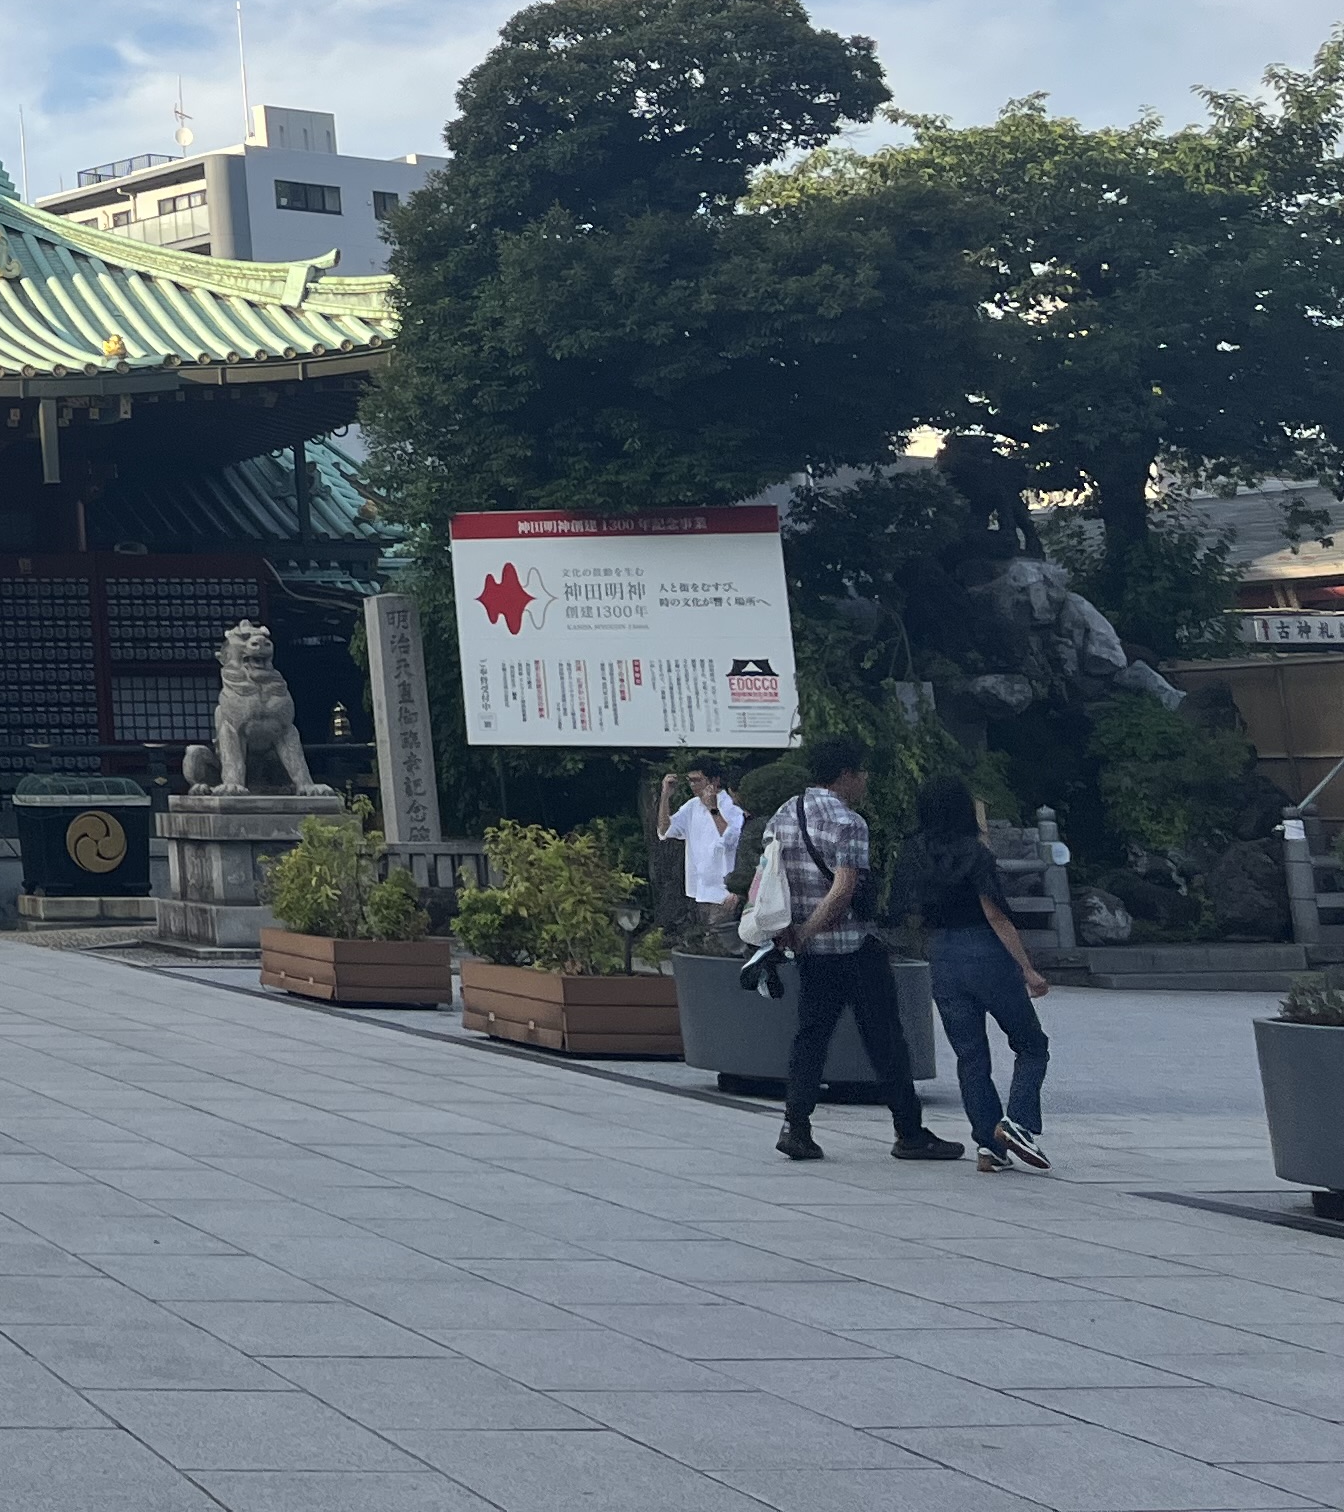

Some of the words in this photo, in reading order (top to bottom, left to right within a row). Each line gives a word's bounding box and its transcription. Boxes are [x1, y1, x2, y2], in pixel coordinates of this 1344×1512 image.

[564, 582, 646, 601] 神田明神
[565, 605, 648, 618] 創建1300年
[729, 677, 778, 691] EDOCCO
